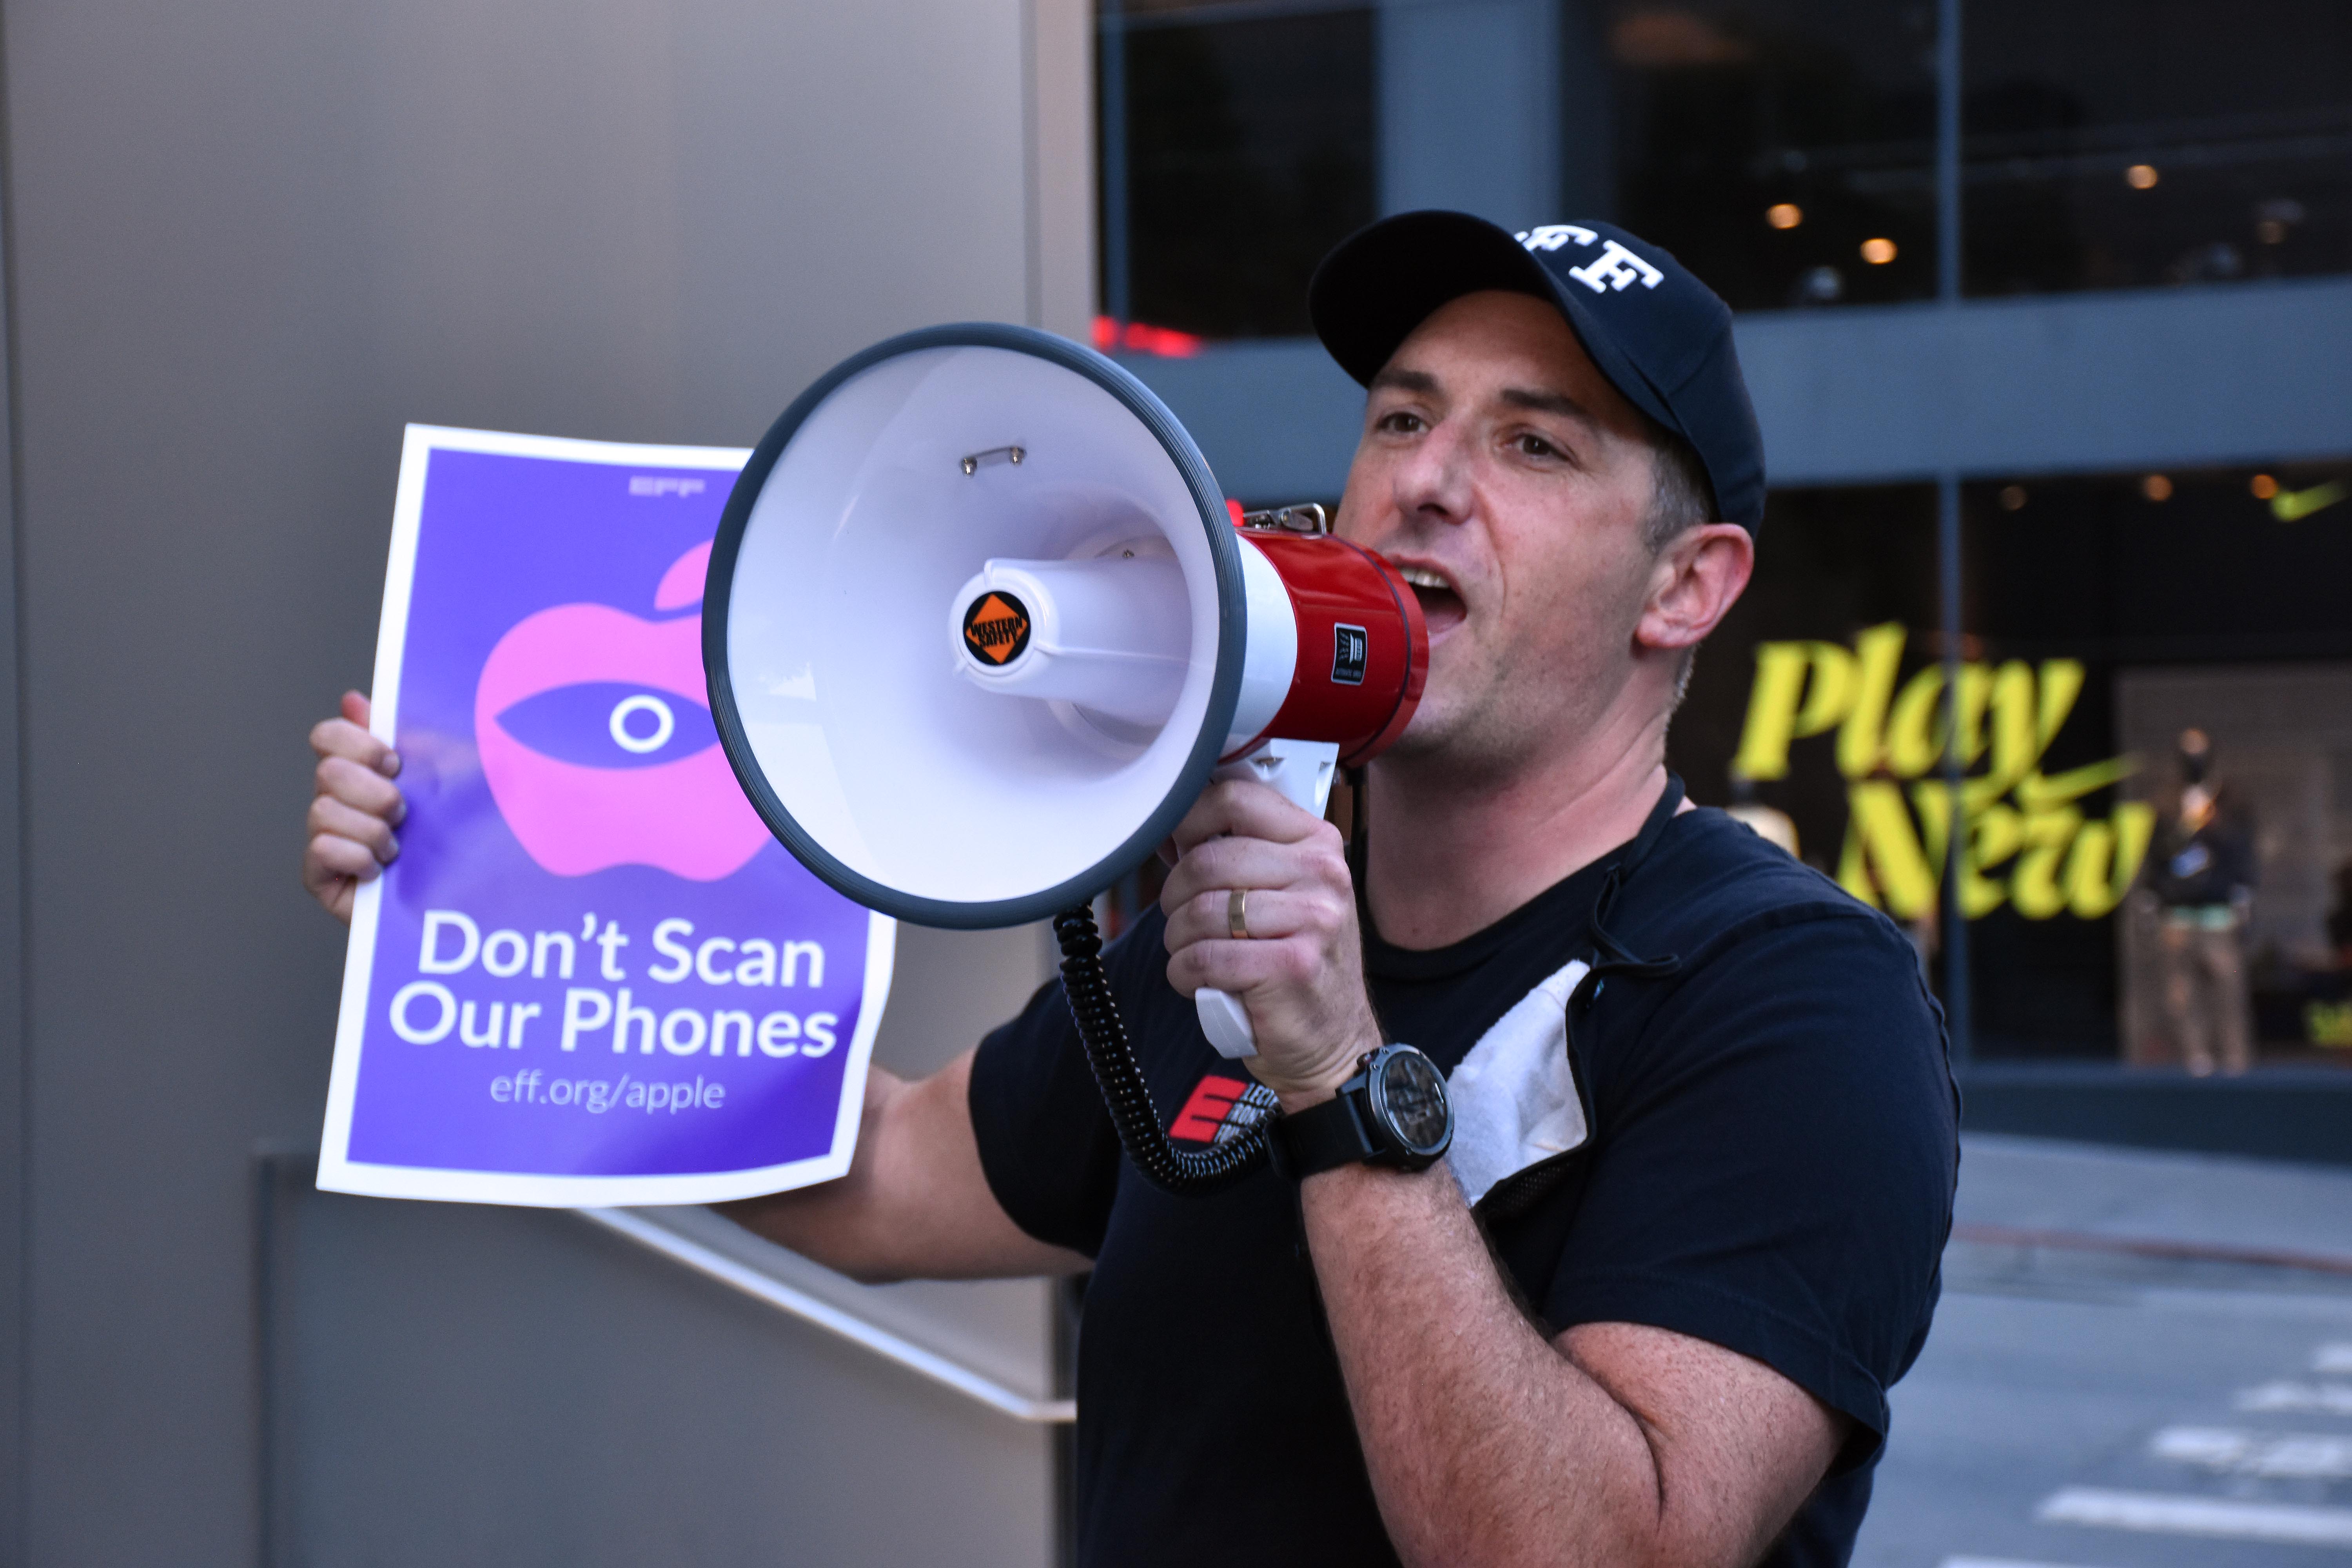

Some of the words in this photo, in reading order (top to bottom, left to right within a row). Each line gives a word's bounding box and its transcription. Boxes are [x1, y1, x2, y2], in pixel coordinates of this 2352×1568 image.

[1515, 224, 1664, 293] FF
[969, 615, 1023, 637] WESTERN
[978, 627, 1019, 647] SAFETY
[1733, 621, 2085, 813] Play
[1835, 778, 2156, 919] New
[418, 909, 630, 982] Don't
[647, 918, 826, 989] Scan
[389, 980, 543, 1050] Our
[560, 987, 839, 1058] Phones
[489, 1068, 726, 1115] eff.org/apple
